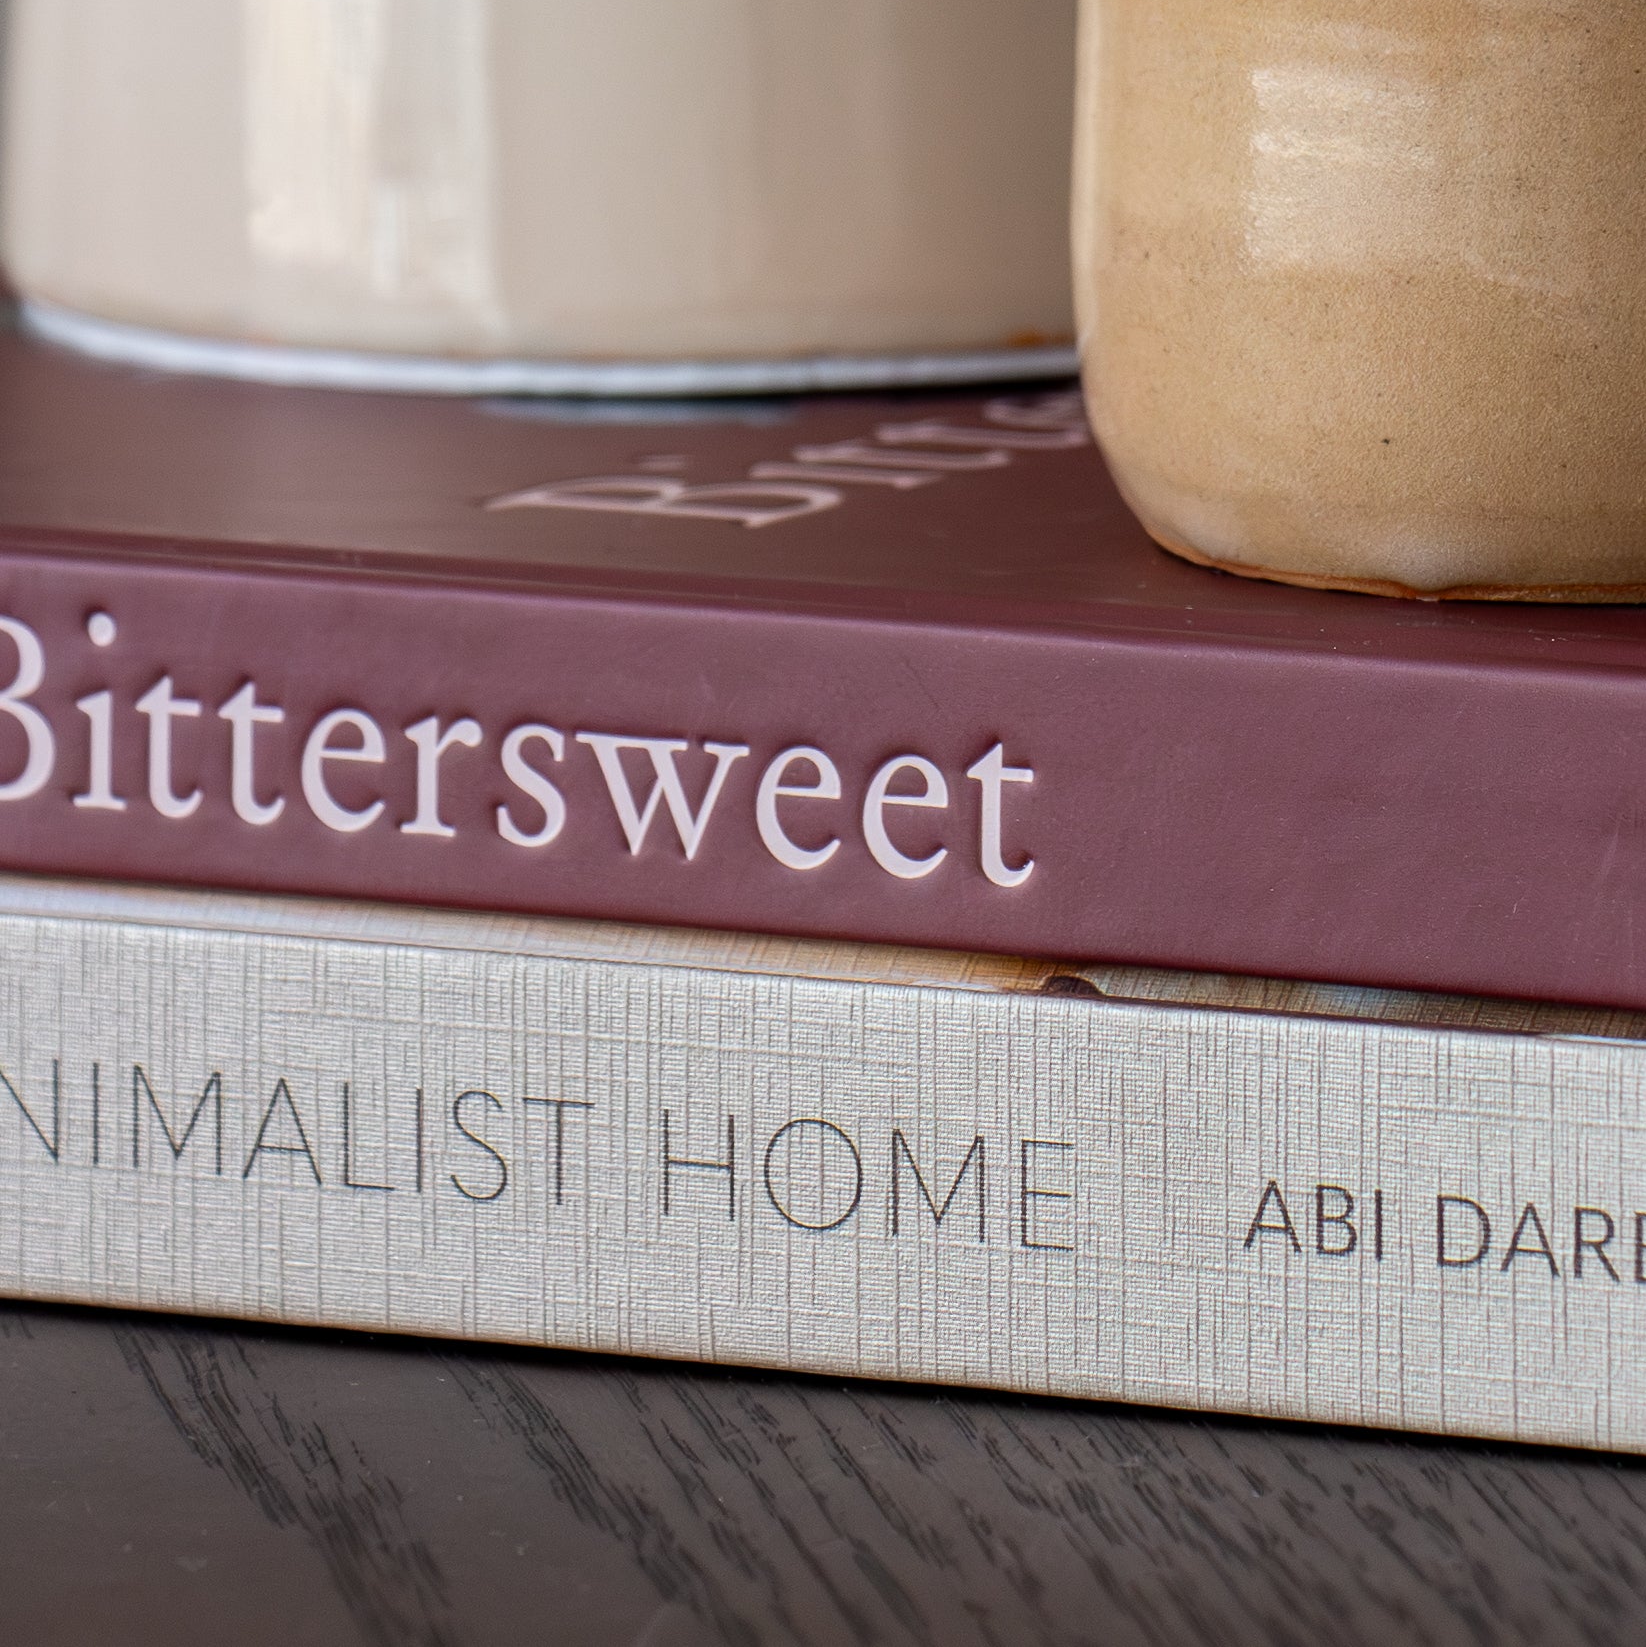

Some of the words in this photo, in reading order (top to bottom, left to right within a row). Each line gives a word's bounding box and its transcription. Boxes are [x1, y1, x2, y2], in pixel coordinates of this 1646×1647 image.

[0, 1057, 595, 1206] NIMALIST
[661, 1108, 1075, 1251] HOME
[1243, 1180, 1383, 1262] ABI
